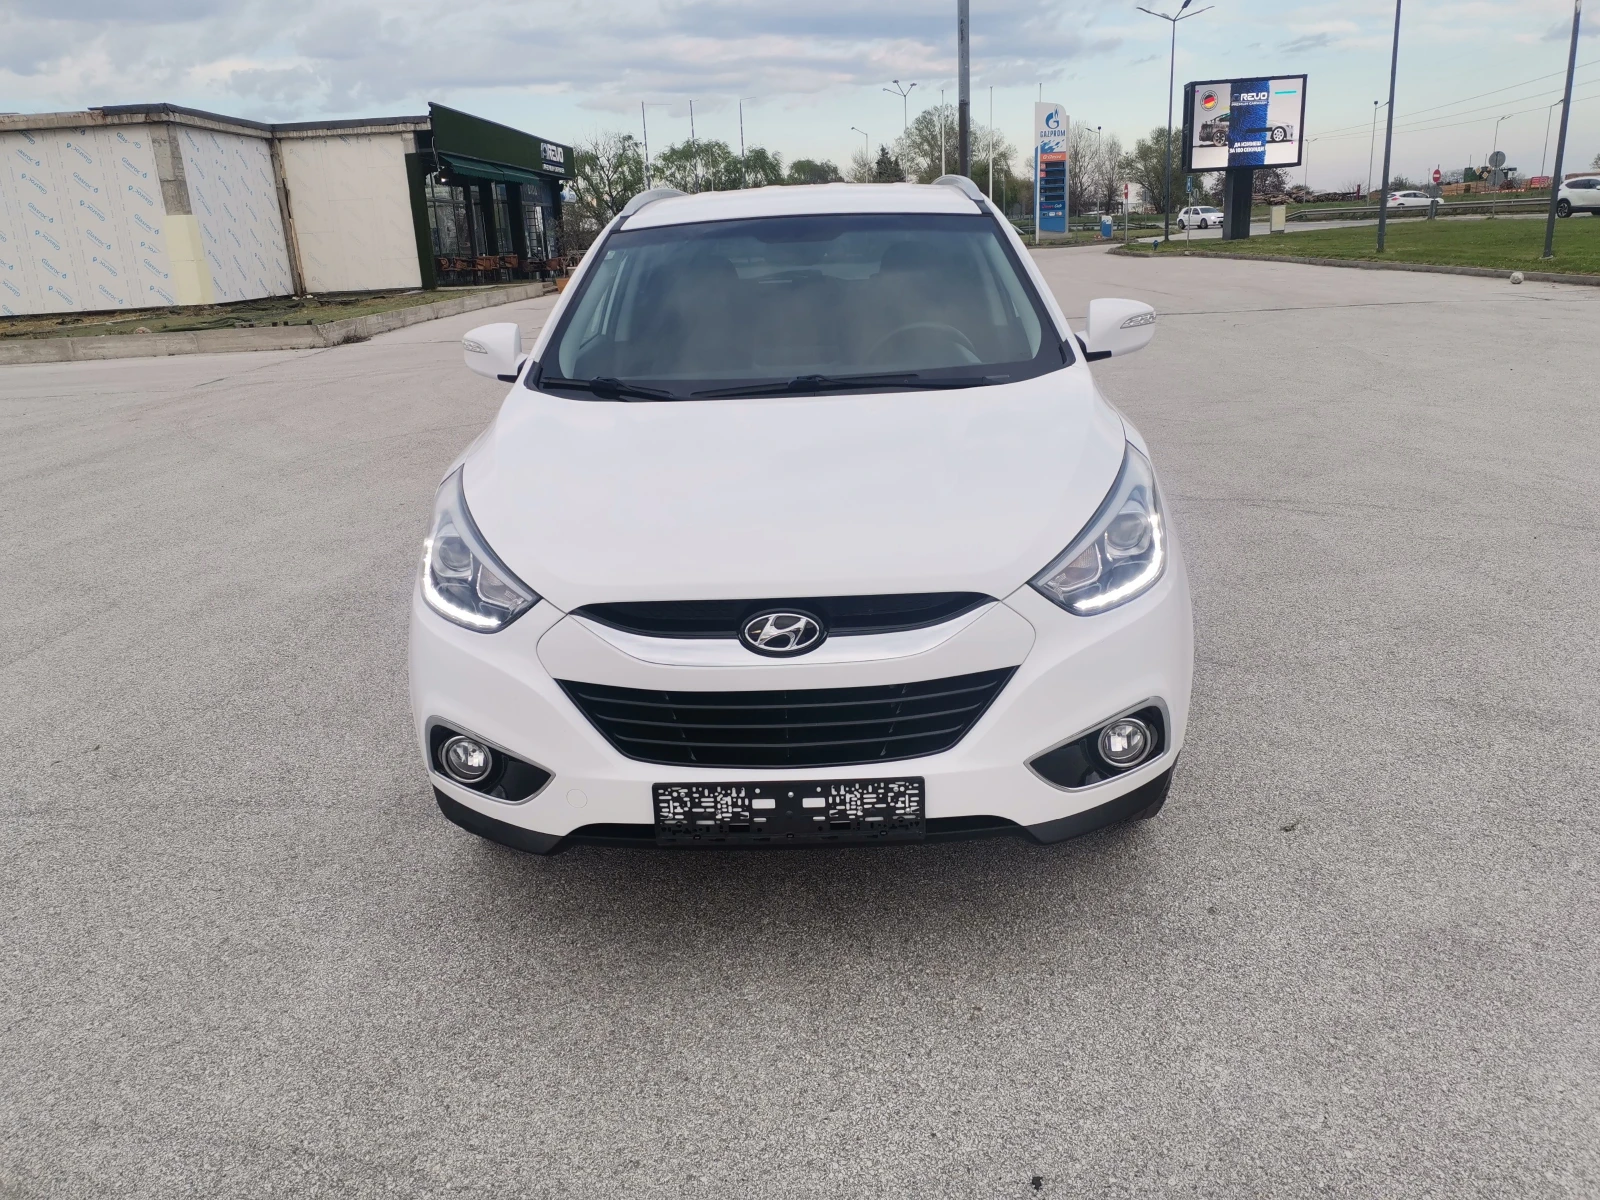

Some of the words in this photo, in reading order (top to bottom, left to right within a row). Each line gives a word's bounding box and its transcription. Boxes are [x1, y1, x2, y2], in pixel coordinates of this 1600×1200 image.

[1240, 92, 1268, 101] REVO
[121, 157, 141, 175] Glasroc
[28, 178, 48, 195] Glasroc
[72, 172, 92, 190] Glasroc
[28, 202, 48, 220] Glasroc
[134, 213, 153, 232] Glasroc
[86, 229, 105, 247] Glasroc
[41, 258, 60, 276] Glasroc
[143, 258, 162, 276] Glasroc
[98, 284, 117, 301] Glasroc
